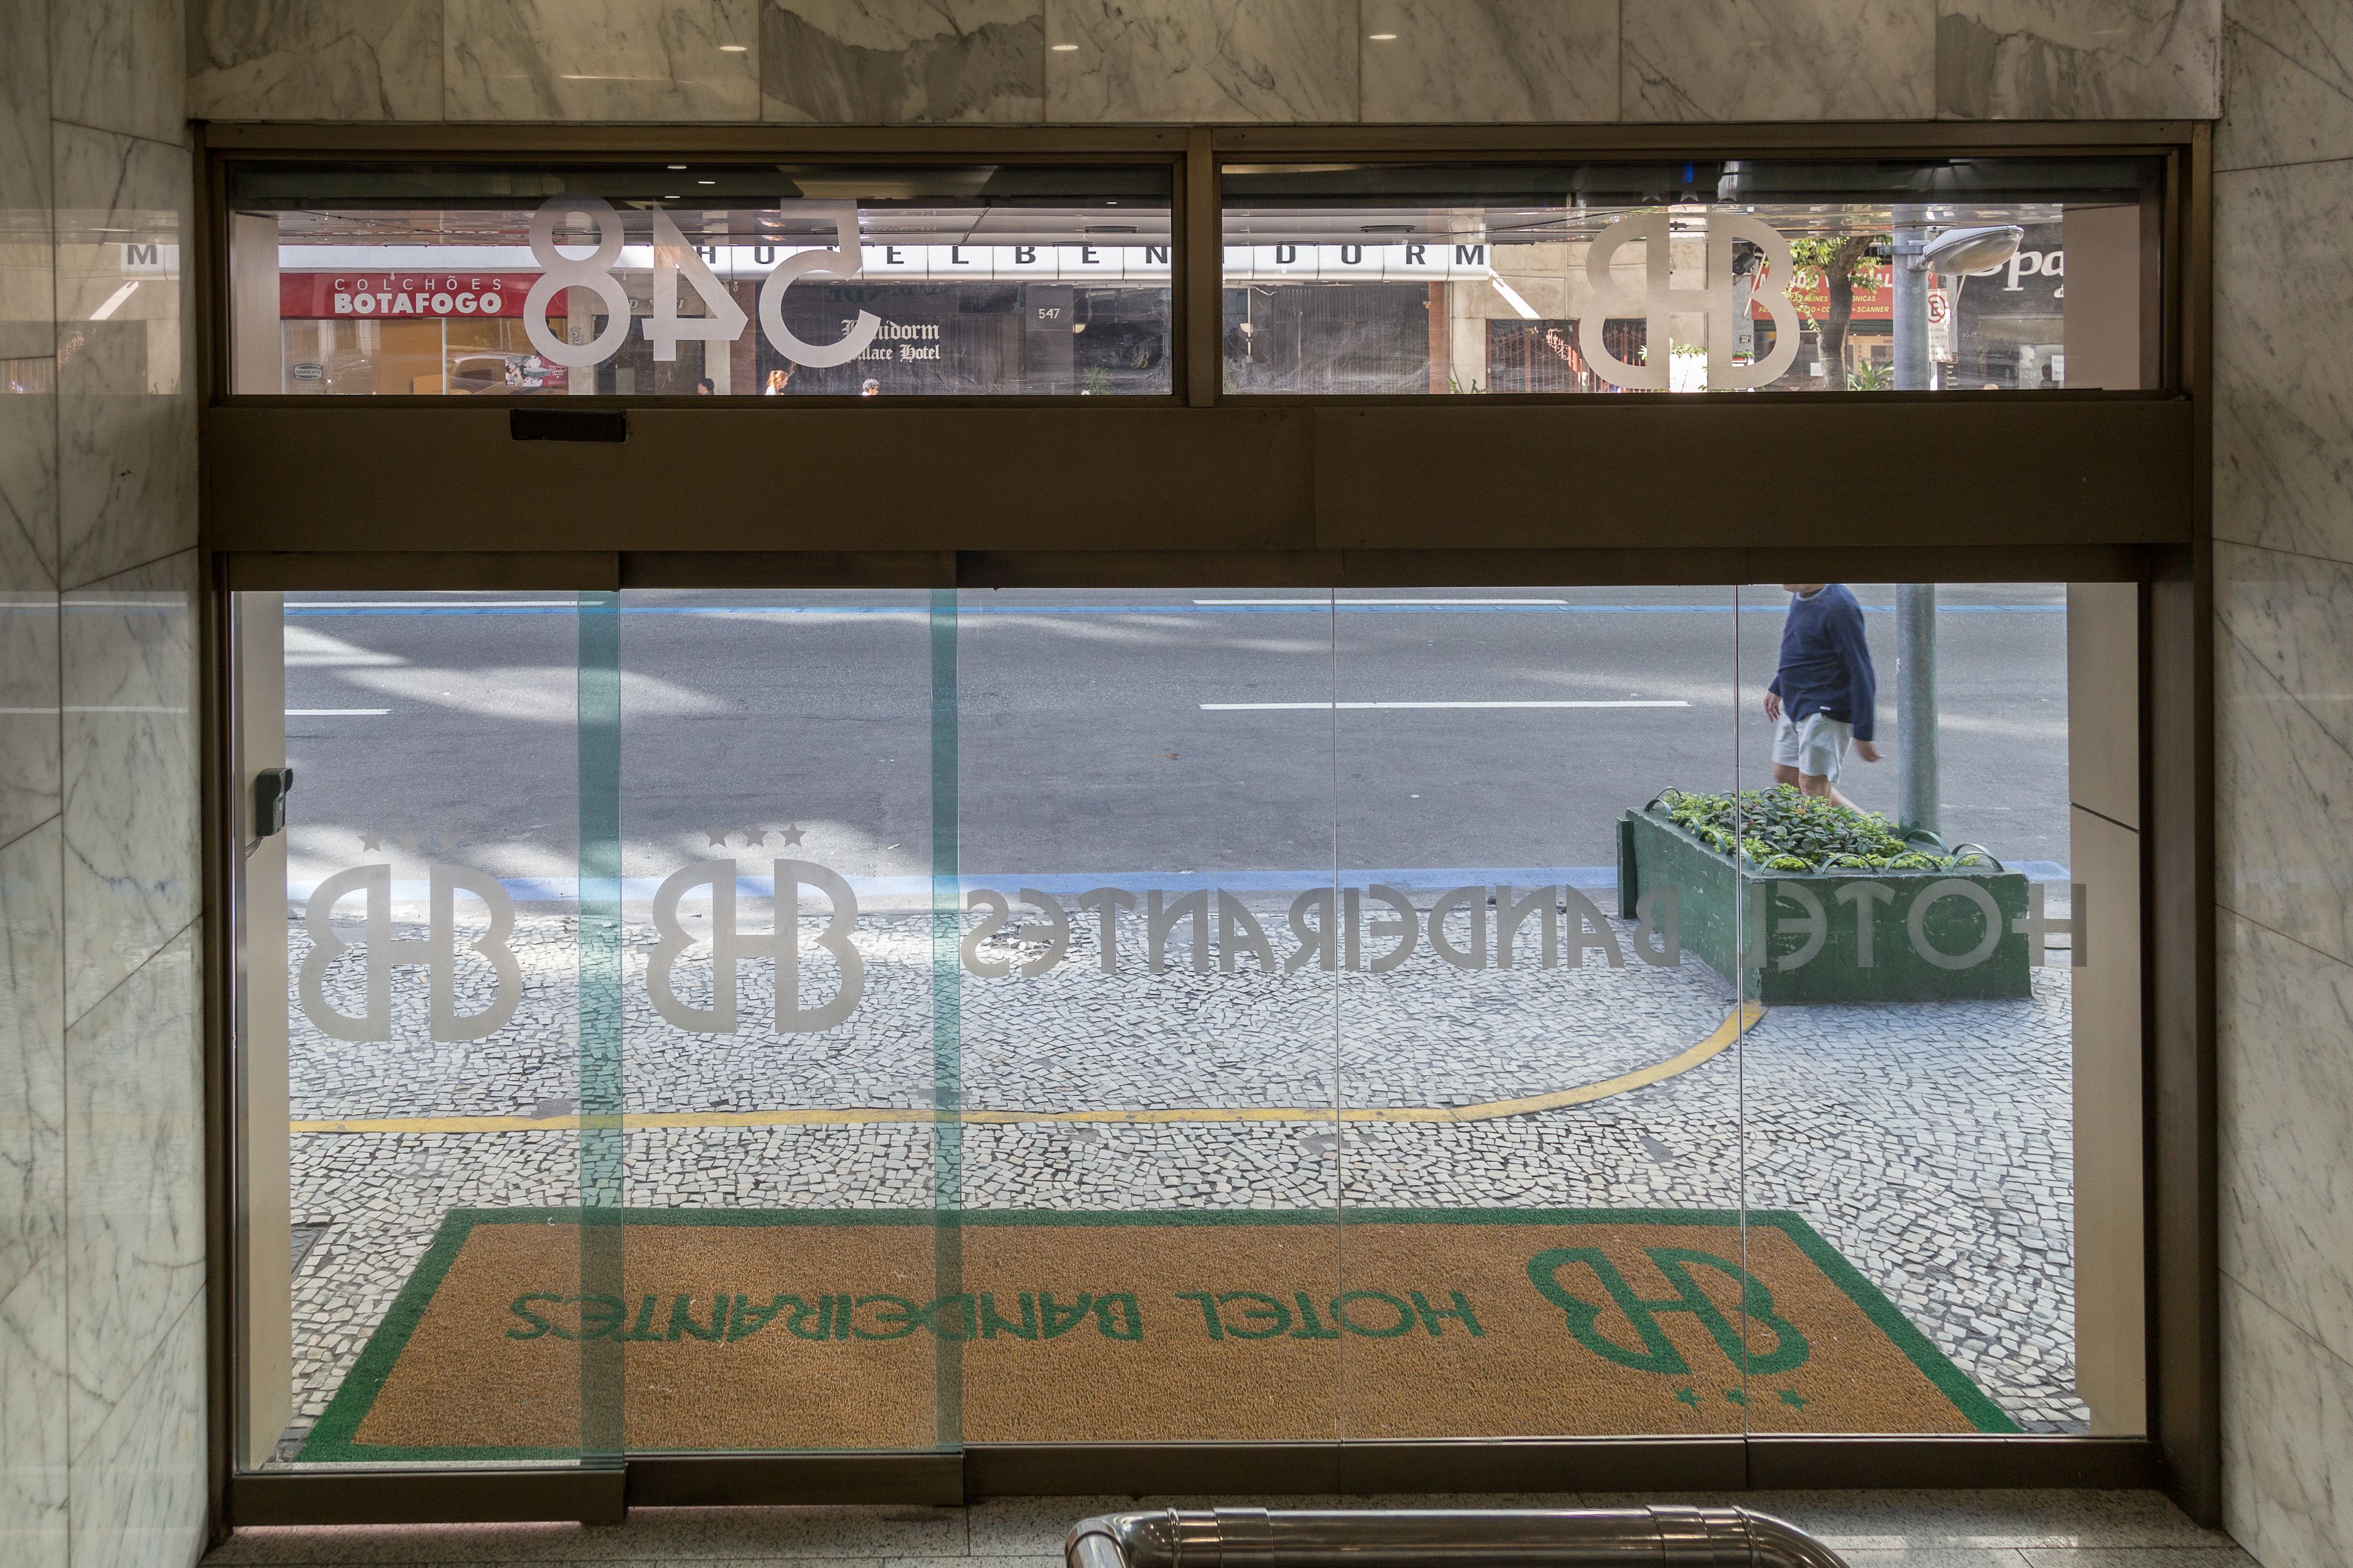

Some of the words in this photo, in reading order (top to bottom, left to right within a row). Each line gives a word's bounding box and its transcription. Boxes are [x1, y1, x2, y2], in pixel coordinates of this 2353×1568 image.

[335, 276, 501, 290] COLCHÕES
[335, 292, 502, 314] BOTAFOGO
[1039, 308, 1060, 319] 547
[899, 344, 941, 363] Hotel
[506, 1291, 1143, 1343] BANDEIRANTES
[1176, 1289, 1485, 1340] HOTEL
